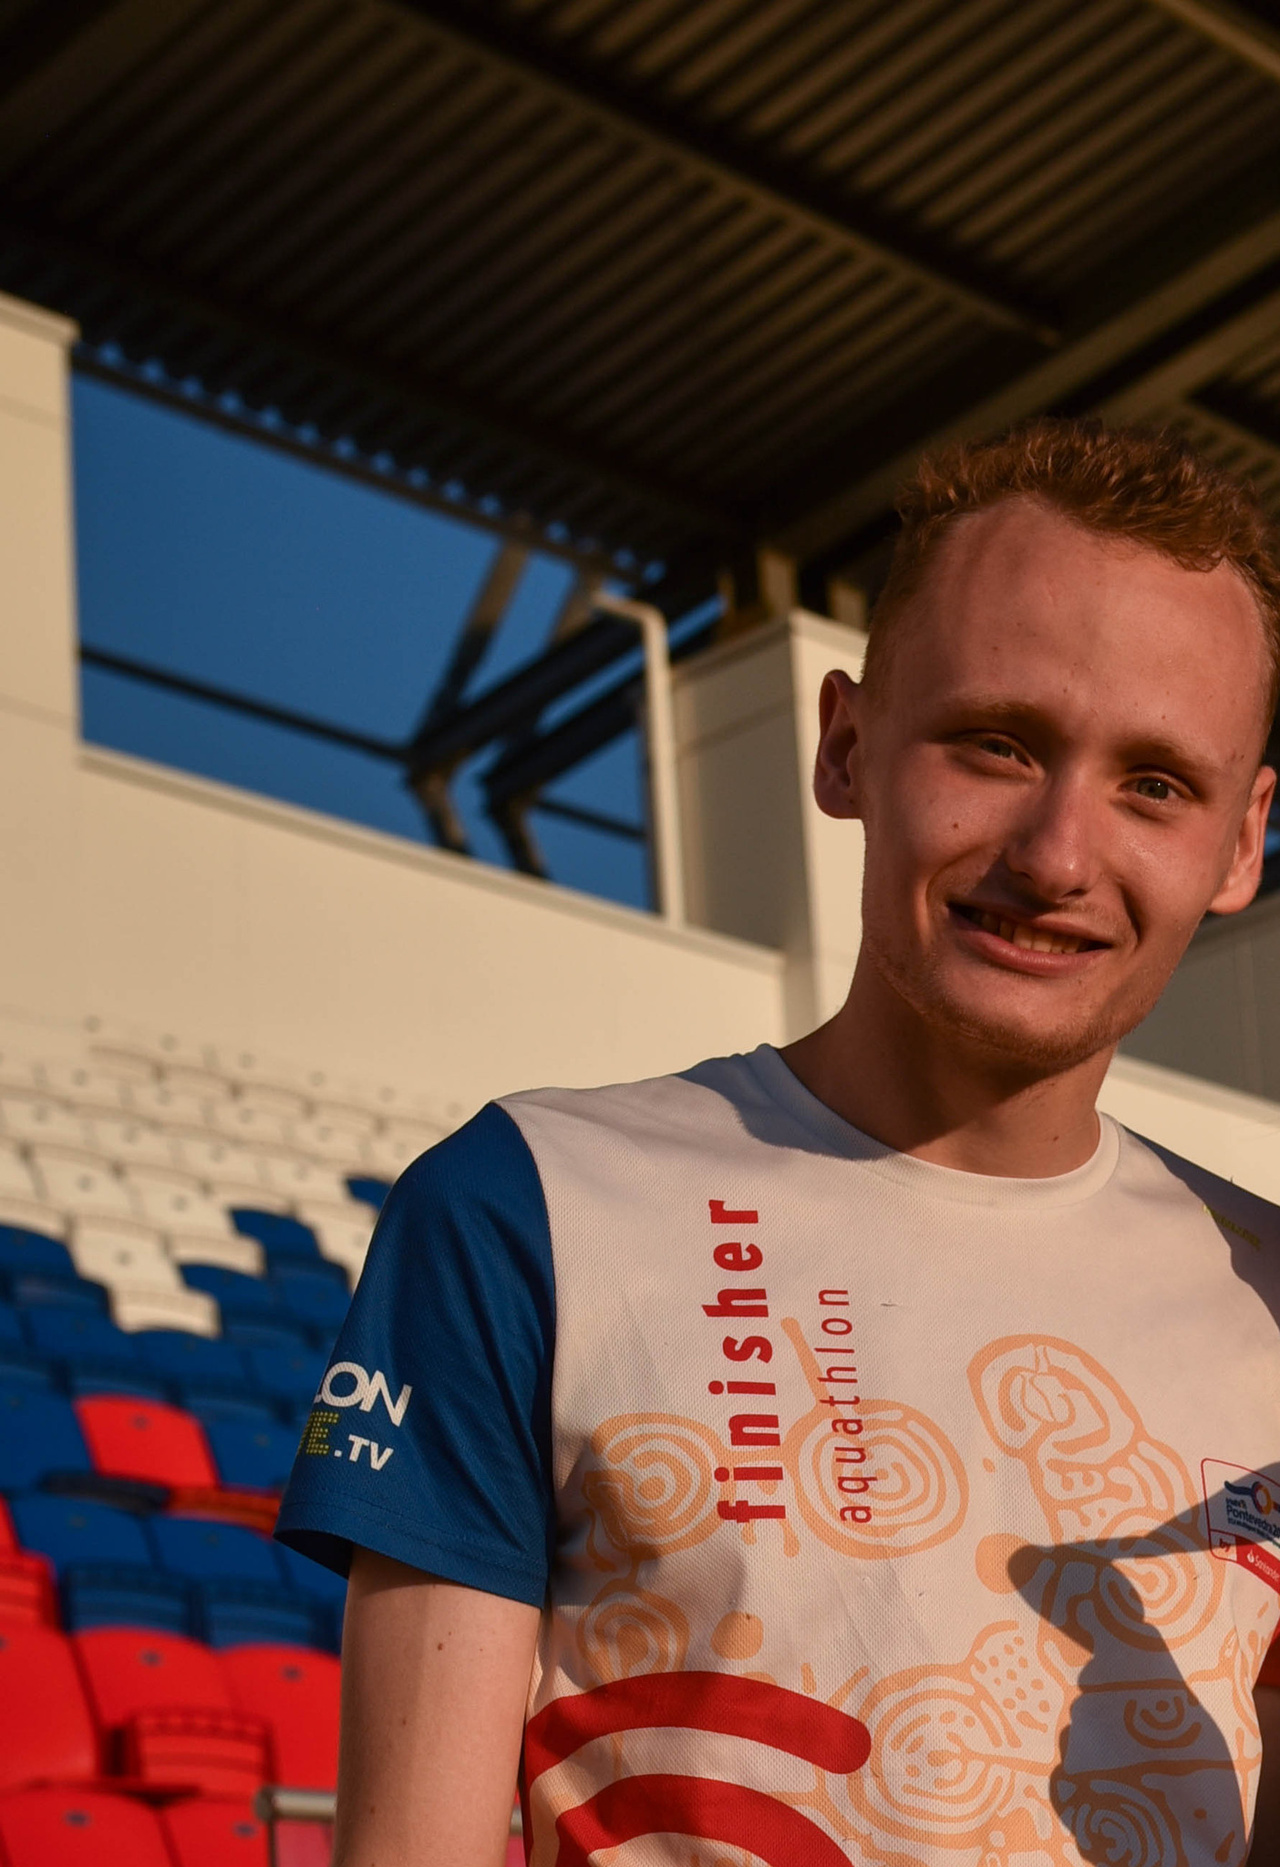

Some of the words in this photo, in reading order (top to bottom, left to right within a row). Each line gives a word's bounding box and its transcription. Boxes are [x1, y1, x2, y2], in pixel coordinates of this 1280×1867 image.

[313, 1361, 413, 1428] ON
[702, 1199, 786, 1523] finisher
[814, 1288, 879, 1524] aquathlon
[298, 1411, 394, 1471] E.TV
